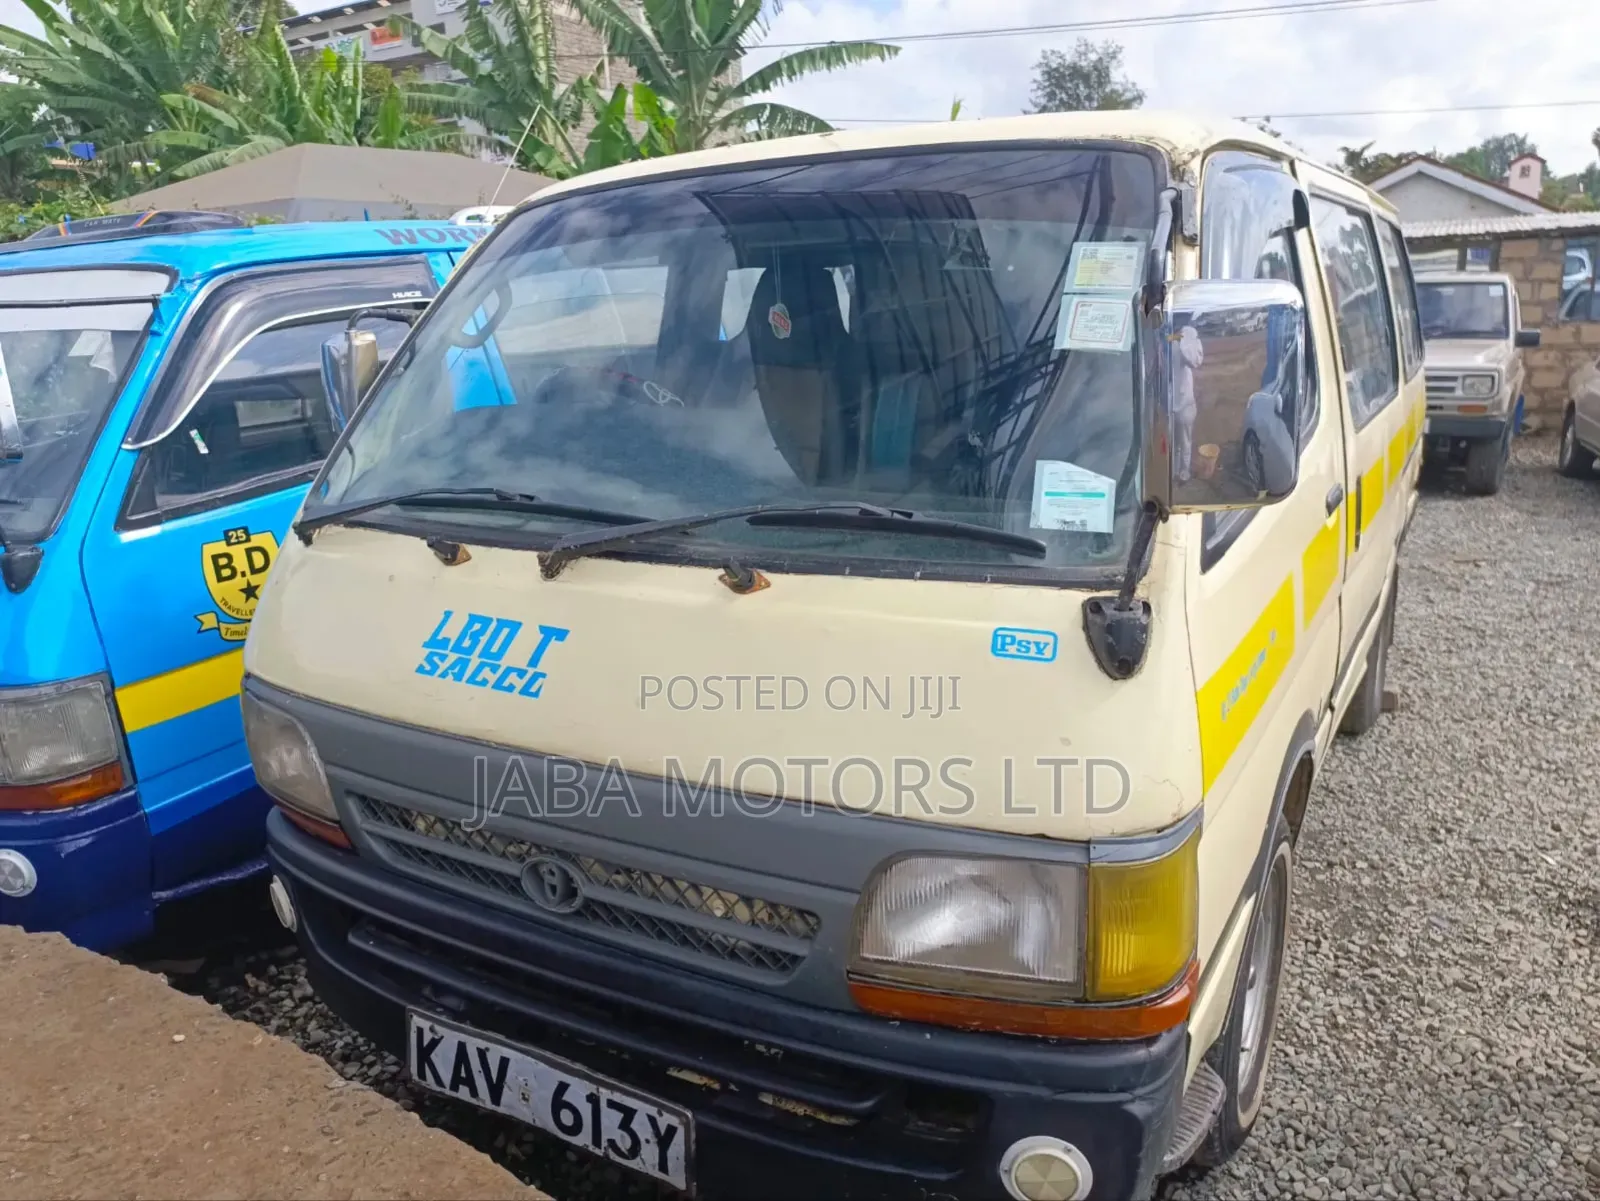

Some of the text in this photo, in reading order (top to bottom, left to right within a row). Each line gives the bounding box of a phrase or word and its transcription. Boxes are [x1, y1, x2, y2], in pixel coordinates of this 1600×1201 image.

[228, 529, 247, 543] 25
[210, 545, 272, 584] B.D
[220, 596, 257, 617] TRAVELLE
[415, 1025, 679, 1176] KAV 613Y
